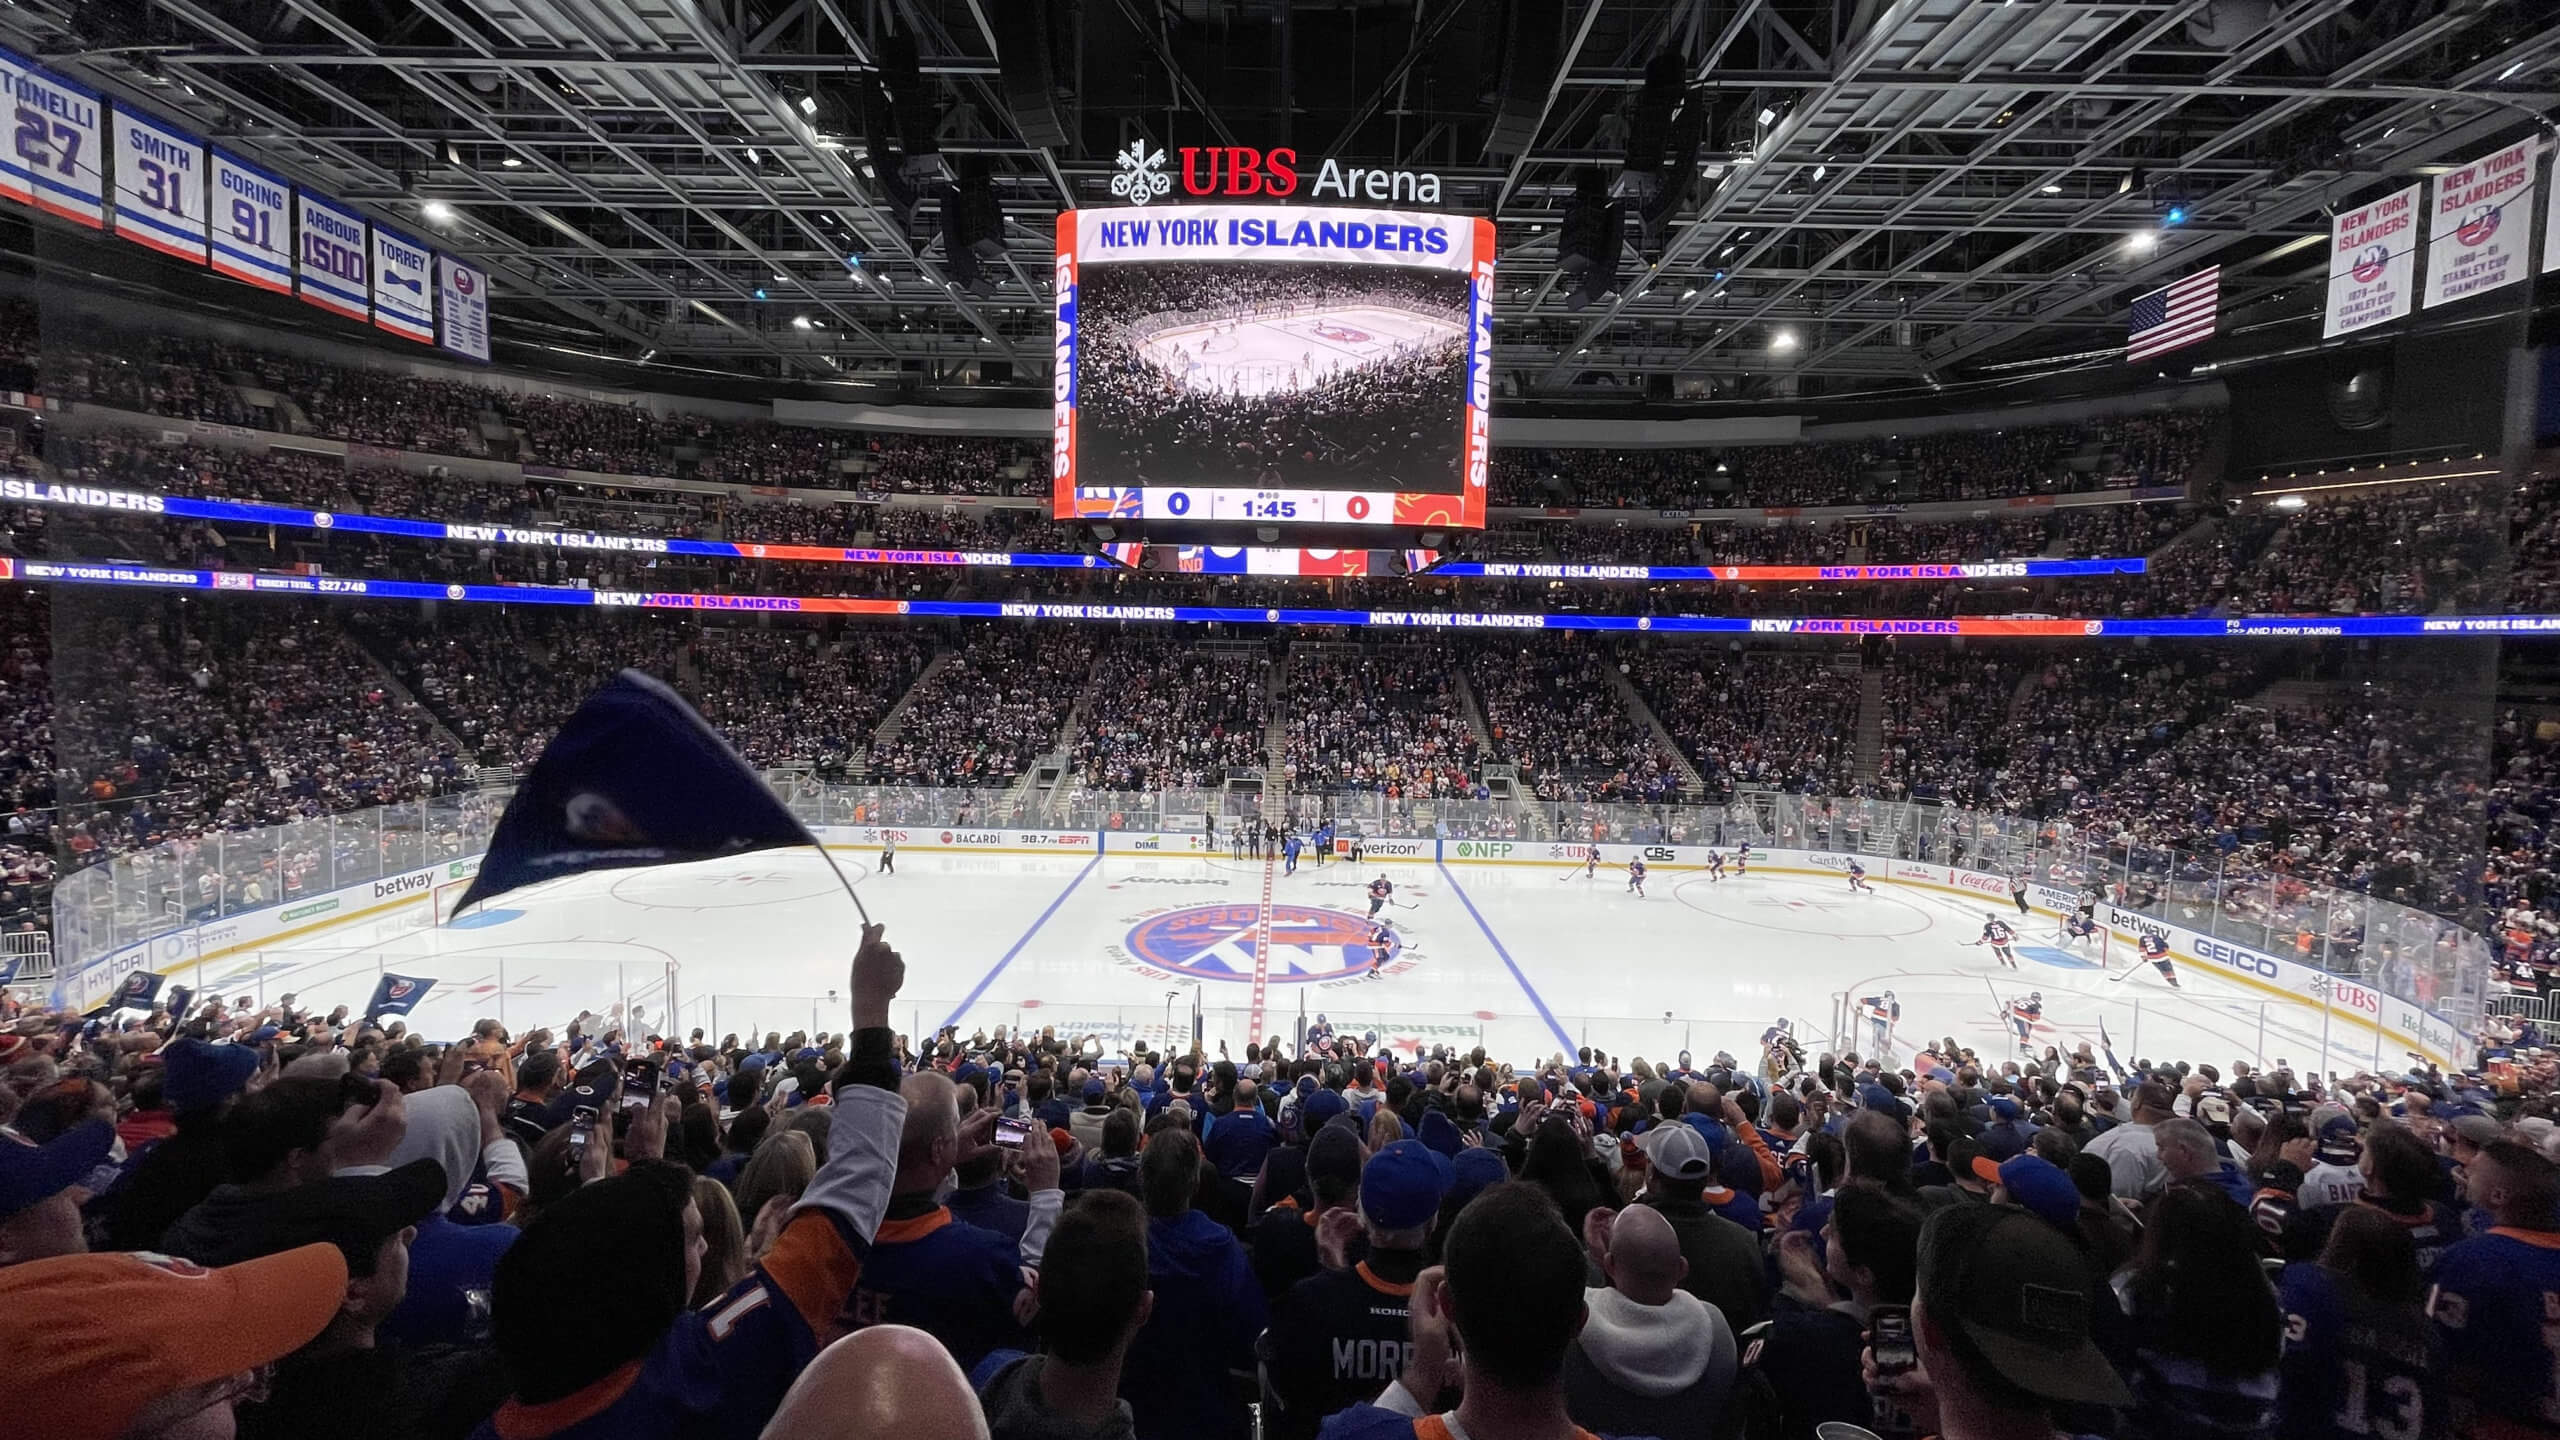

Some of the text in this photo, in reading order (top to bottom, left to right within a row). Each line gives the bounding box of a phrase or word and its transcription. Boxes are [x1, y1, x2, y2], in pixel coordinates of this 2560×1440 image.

[2, 72, 94, 129] TONELLI
[14, 107, 82, 177] 27
[130, 127, 191, 172] SMITH
[1179, 147, 1441, 203] UBS Arena
[2442, 146, 2525, 193] NEW YORK
[138, 158, 184, 217] 31
[220, 169, 283, 211] GORING
[2440, 167, 2526, 214] ISLANDERS
[231, 198, 273, 251] 91
[305, 207, 361, 246] ARBOUR
[2341, 192, 2410, 233] NEW YORK
[1101, 218, 1449, 255] NEW YORK ISLANDERS
[2338, 213, 2409, 253] ISLANDERS
[302, 231, 365, 284] 1500
[379, 239, 425, 273] TORREY
[2441, 254, 2510, 285] STANLEY CUP
[2442, 270, 2506, 299] CHAMPIONS
[2338, 291, 2397, 318] STANLEY CUP
[2340, 305, 2393, 330] CHAMPIONS
[1055, 252, 1072, 479] ISLANDERS
[1470, 260, 1493, 488] ISLANDERS
[1167, 491, 1370, 520] 0 1:45 0
[447, 524, 667, 552] NEW YORK ISLANDERS
[844, 549, 1012, 566] NEW YORK ISLANDERS
[1484, 563, 1650, 579] NEW YORK ISLANDERS
[1820, 563, 2028, 579] NEW YORK ISLANDERS
[25, 564, 65, 577] NEW
[67, 566, 112, 580] YORK
[113, 569, 198, 584] ISLANDERS
[594, 590, 800, 611] NEW YORK ISLANDERS
[1001, 603, 1176, 620] NEW YORK ISLANDERS
[1370, 611, 1545, 628] NEW YORK ISLANDERS
[1751, 619, 1960, 634] NEW YORK ISLANDERS
[2246, 627, 2341, 635] AND NOW TAKING
[2423, 620, 2461, 631] NEW
[2464, 620, 2509, 631] YORK
[881, 830, 908, 842] UBS
[1021, 834, 1048, 844] 98.7
[1058, 835, 1090, 845] ESPN
[1135, 841, 1160, 850] DIME
[1363, 843, 1416, 856] verizon
[1475, 843, 1513, 858] NFP
[374, 871, 434, 898] betway
[2037, 887, 2080, 905] AMERIC
[2045, 898, 2080, 915] EXPRE
[2111, 908, 2171, 941] betway
[2193, 937, 2278, 979] GEICO
[2335, 982, 2378, 1013] UBS
[1333, 1021, 1479, 1038] Heineken
[2335, 1360, 2425, 1440] 13
